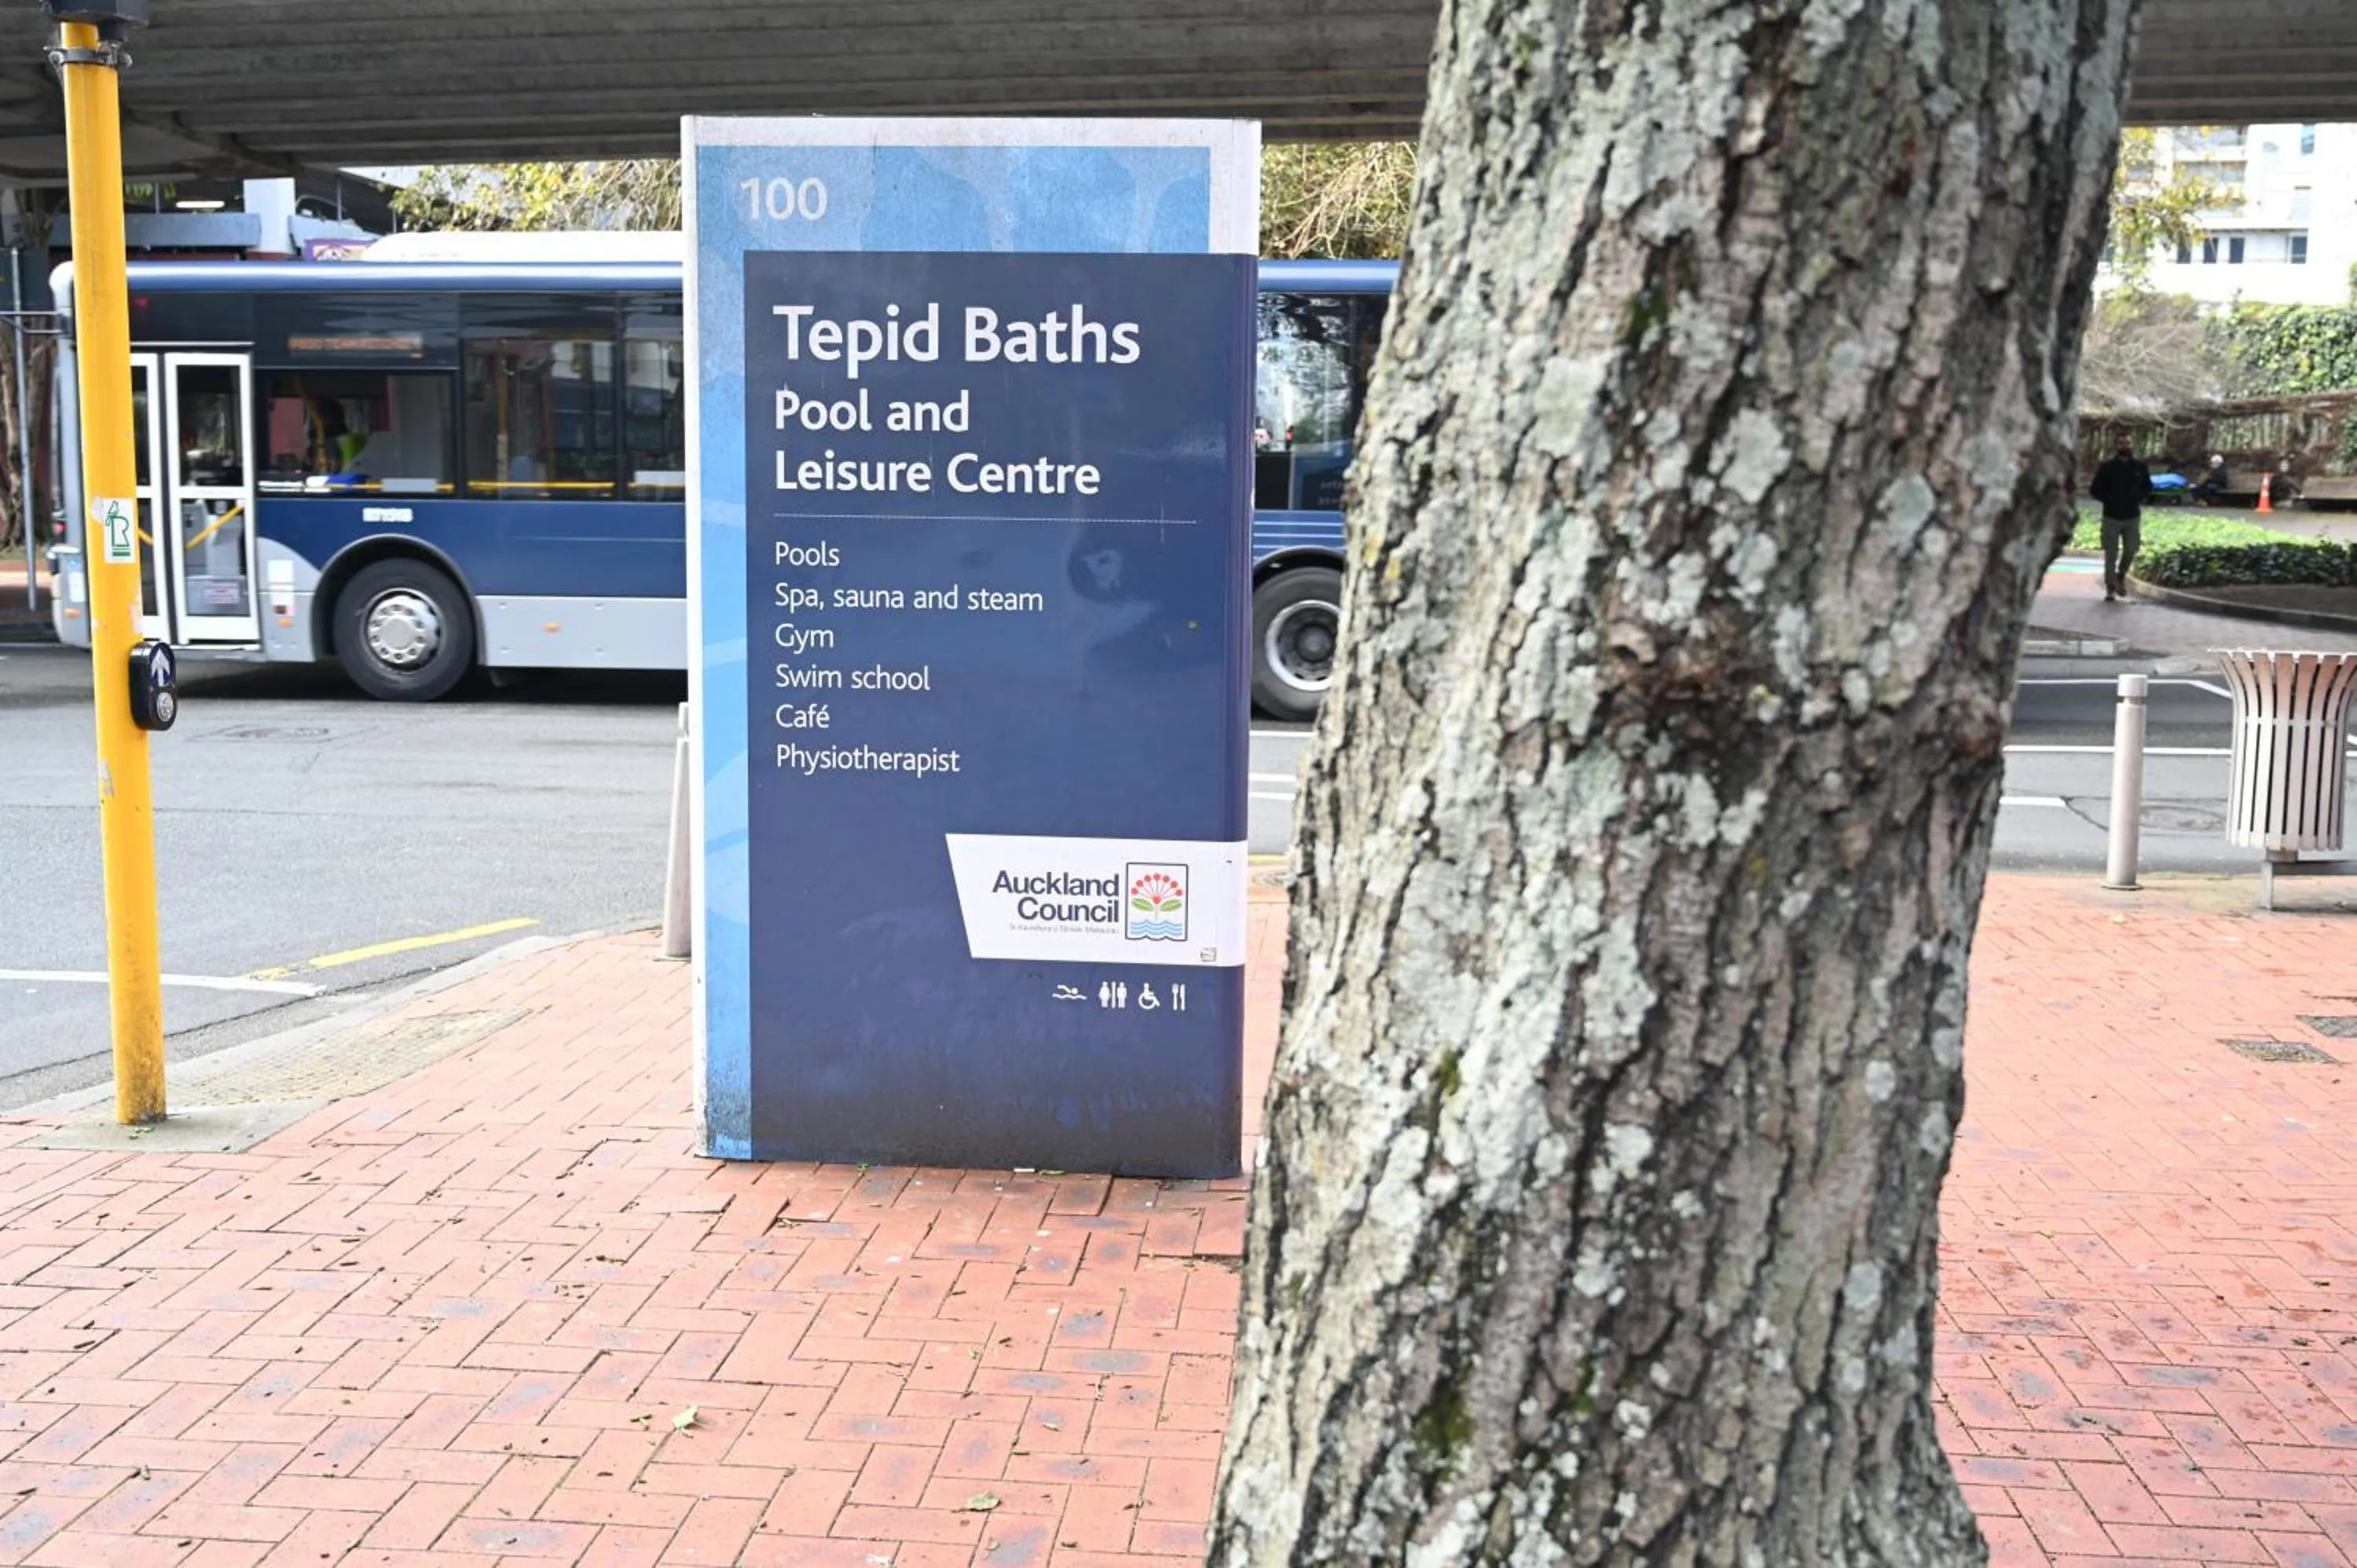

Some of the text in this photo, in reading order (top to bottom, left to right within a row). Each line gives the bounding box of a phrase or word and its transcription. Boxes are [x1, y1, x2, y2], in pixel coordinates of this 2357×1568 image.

[739, 176, 828, 221] 100
[772, 302, 1141, 379] Tepid Baths
[775, 386, 970, 432] Pool and
[775, 449, 1102, 495] Leisure Centre
[775, 540, 840, 566] Pools
[775, 582, 1043, 614] Spa, sauna and steam
[775, 623, 834, 654] Gym
[775, 663, 931, 691] Swim school
[775, 703, 830, 729] Café
[776, 742, 960, 779] Physiotherapist
[992, 870, 1120, 898] Auckland
[1017, 897, 1120, 924] Council
